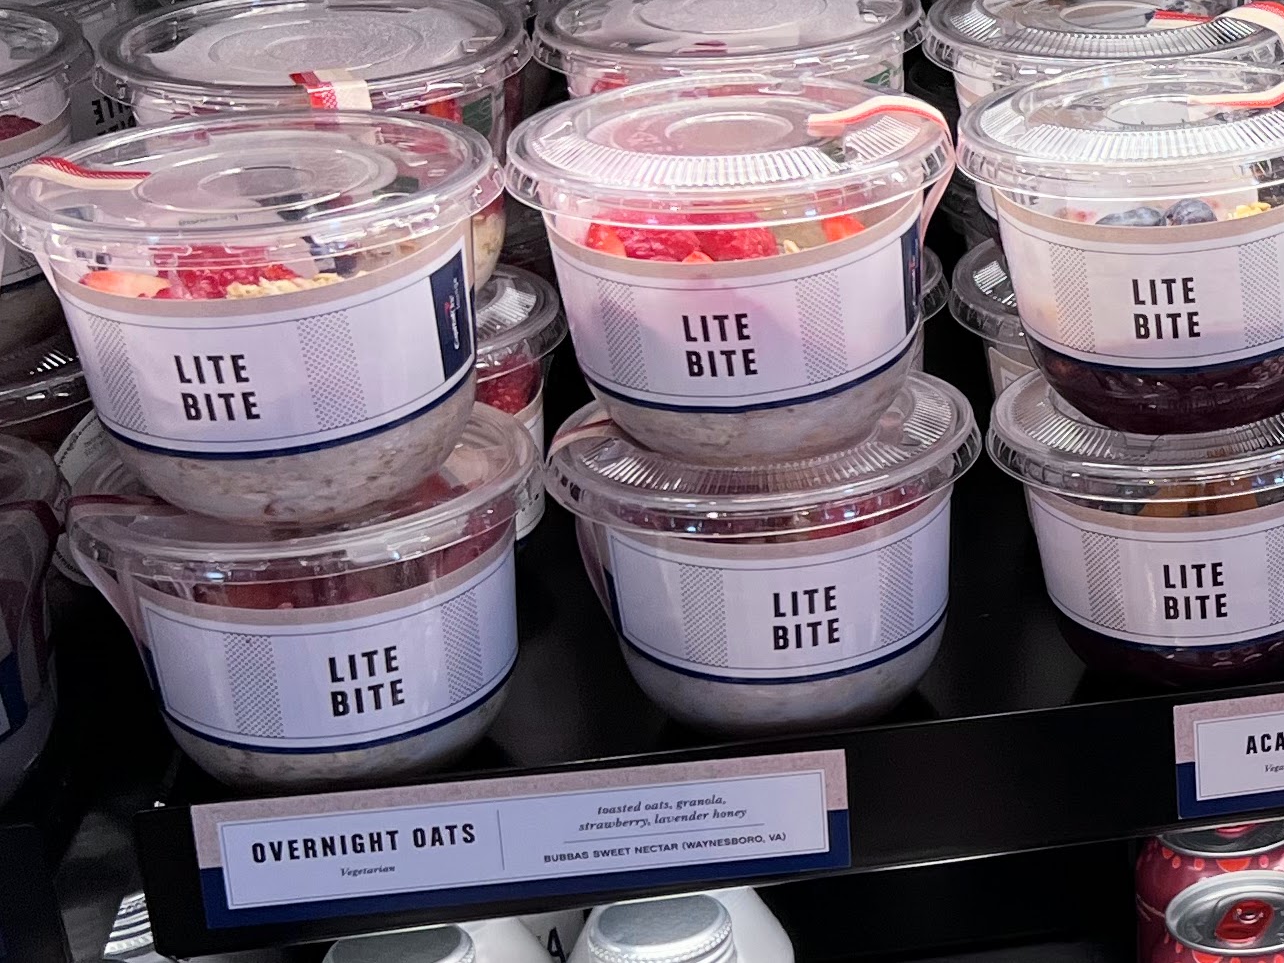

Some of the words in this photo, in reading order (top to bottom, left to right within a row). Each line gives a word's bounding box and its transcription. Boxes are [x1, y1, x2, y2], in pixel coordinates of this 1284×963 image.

[1132, 277, 1196, 305] LITE
[681, 313, 751, 342] LITE
[1134, 312, 1200, 339] BITE
[174, 354, 250, 386] LITE
[686, 348, 758, 378] BITE
[180, 391, 261, 422] BITE
[1163, 562, 1224, 589] LITE
[773, 585, 837, 618] LITE
[1164, 593, 1228, 620] BITE
[773, 618, 840, 650] BITE
[328, 645, 399, 683] LITE
[330, 679, 405, 717] BITE
[579, 812, 651, 832] strawberry,
[654, 809, 709, 825] lavender
[712, 807, 747, 820] honey
[598, 801, 641, 815] toasted
[645, 798, 673, 811] oats,
[676, 795, 727, 811] granola,
[251, 829, 400, 865] OVERNIGHT
[413, 822, 476, 850] OATS
[544, 850, 590, 863] BUBBAS
[593, 846, 631, 858] SWEET
[634, 843, 679, 854] NECTAR
[682, 834, 766, 851] (WAYNESBORO,
[769, 831, 787, 842] VA)
[340, 863, 396, 878] Vegetarian
